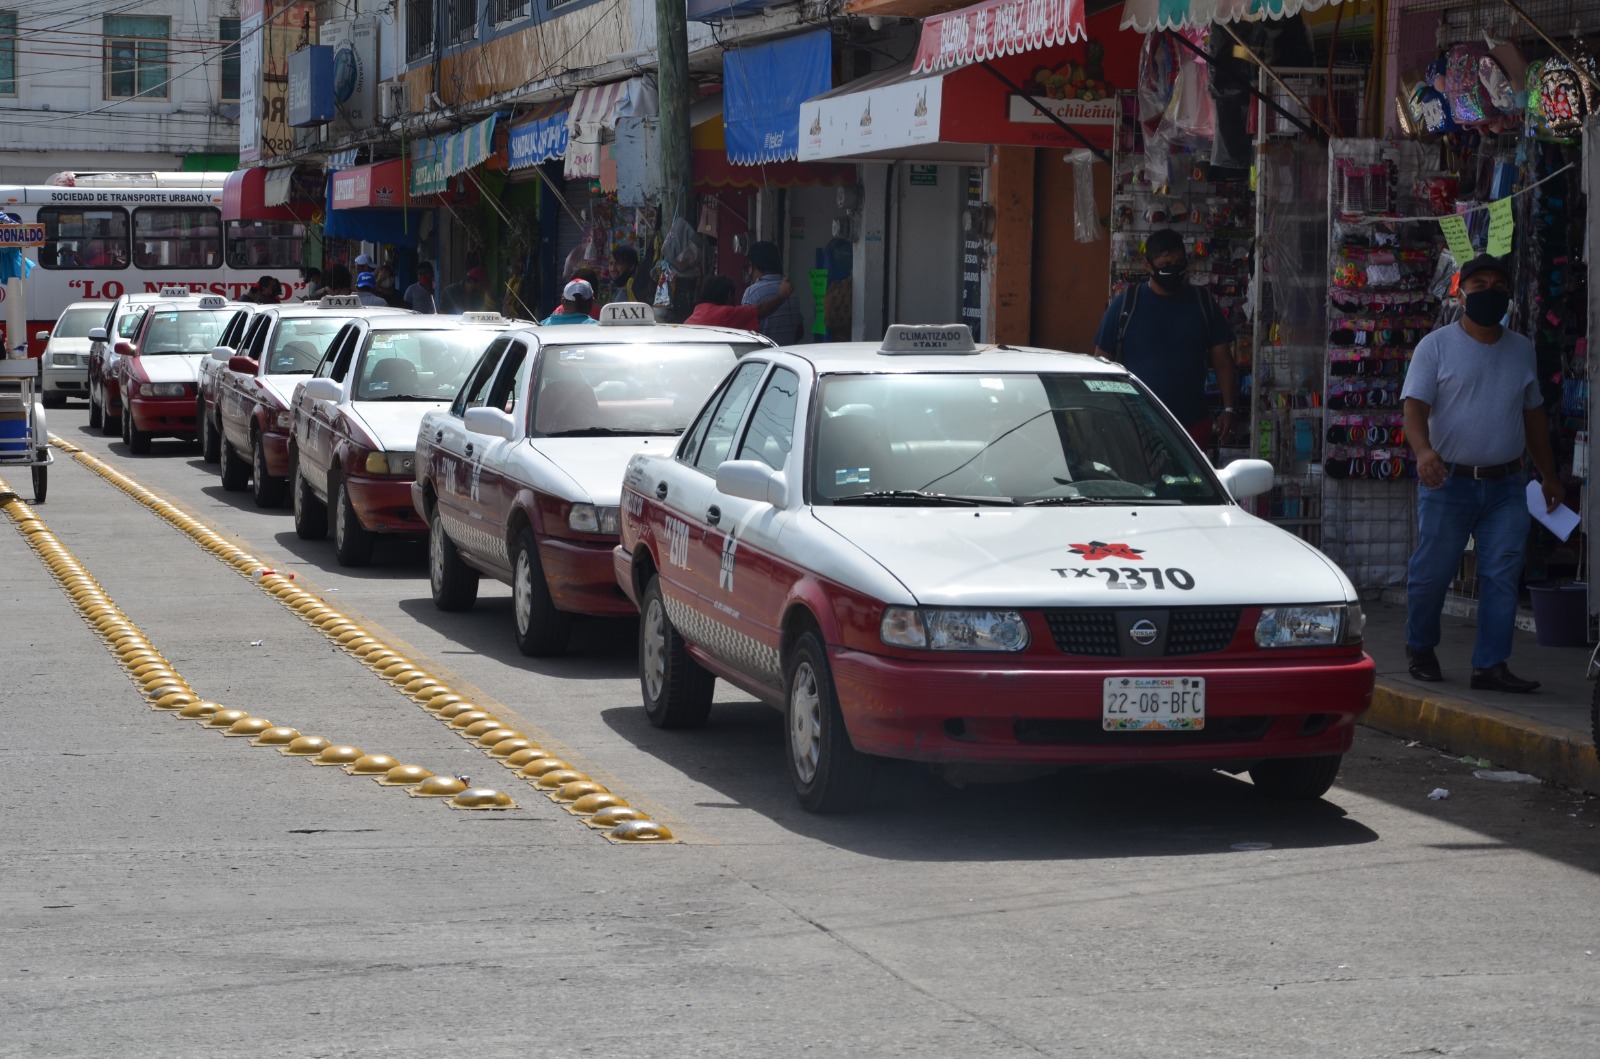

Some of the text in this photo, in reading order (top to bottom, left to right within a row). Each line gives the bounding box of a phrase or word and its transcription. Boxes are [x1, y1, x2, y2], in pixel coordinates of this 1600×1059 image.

[51, 192, 212, 202] SOCIEDAD DE TRANSPORTE URBANO Y
[203, 297, 223, 305] TAXI
[327, 298, 356, 306] TAXI
[609, 306, 647, 320] TAXI
[900, 331, 960, 341] CLIMATIZADO
[722, 554, 735, 572] TAXI
[1050, 567, 1196, 591] TX 2370
[1108, 691, 1201, 714] 22-08-BFC
